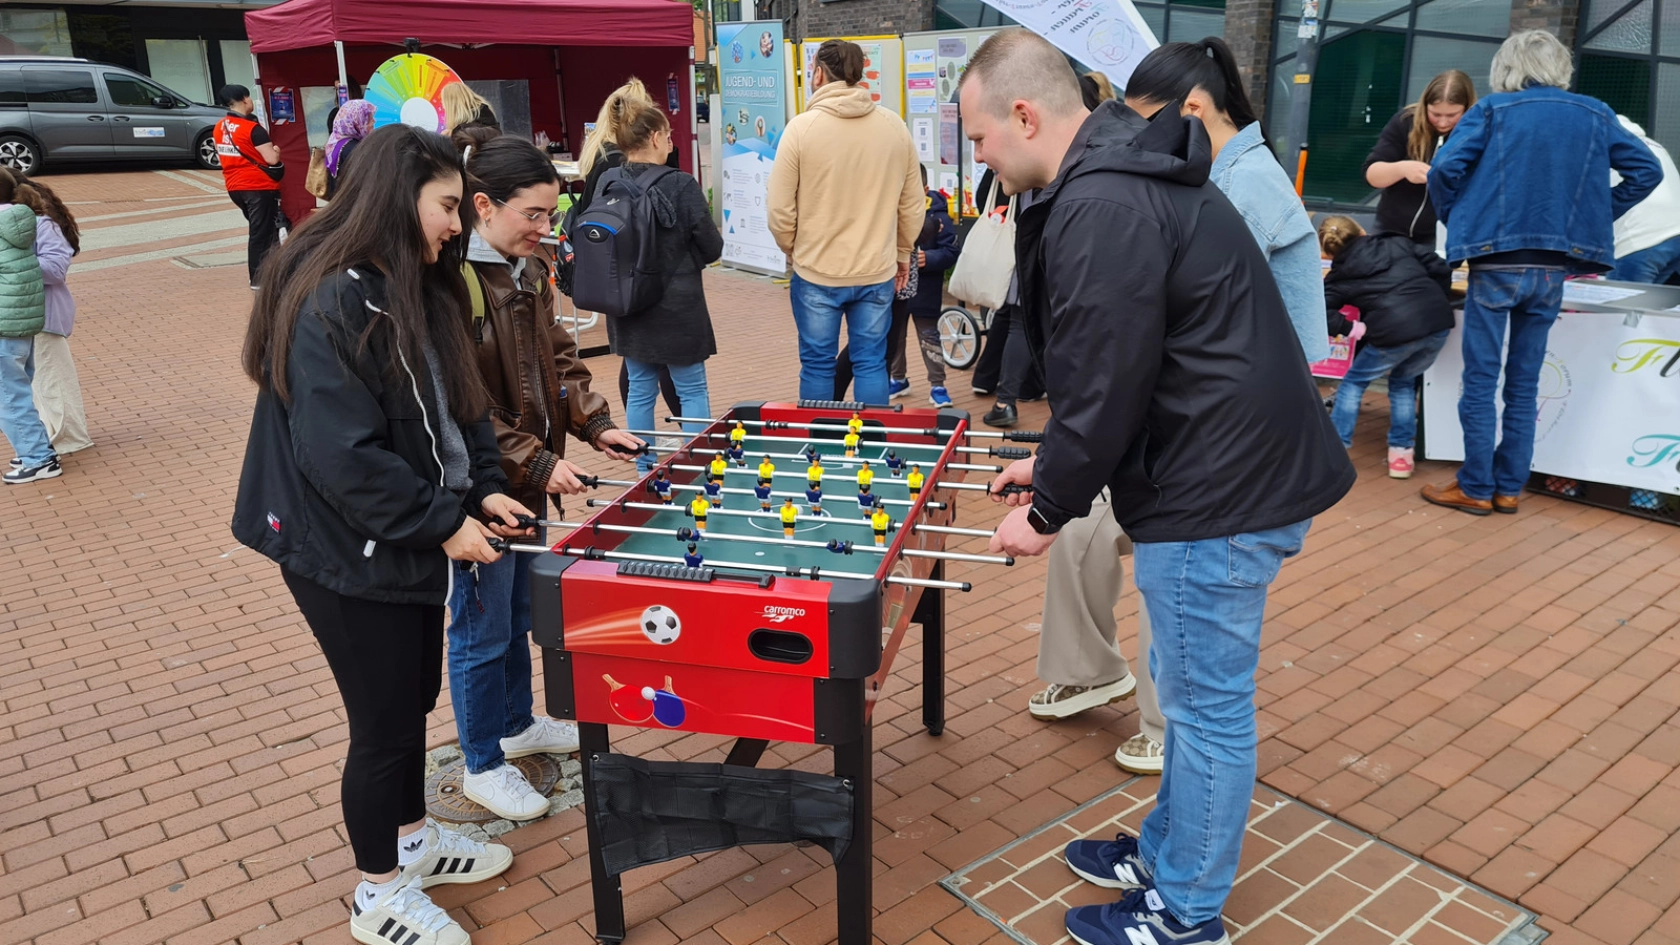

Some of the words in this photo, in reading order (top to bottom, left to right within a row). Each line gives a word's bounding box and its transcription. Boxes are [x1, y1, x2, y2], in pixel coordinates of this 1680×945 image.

[725, 76, 757, 87] JUGEND-
[758, 76, 775, 88] UND
[764, 605, 806, 617] carromco
